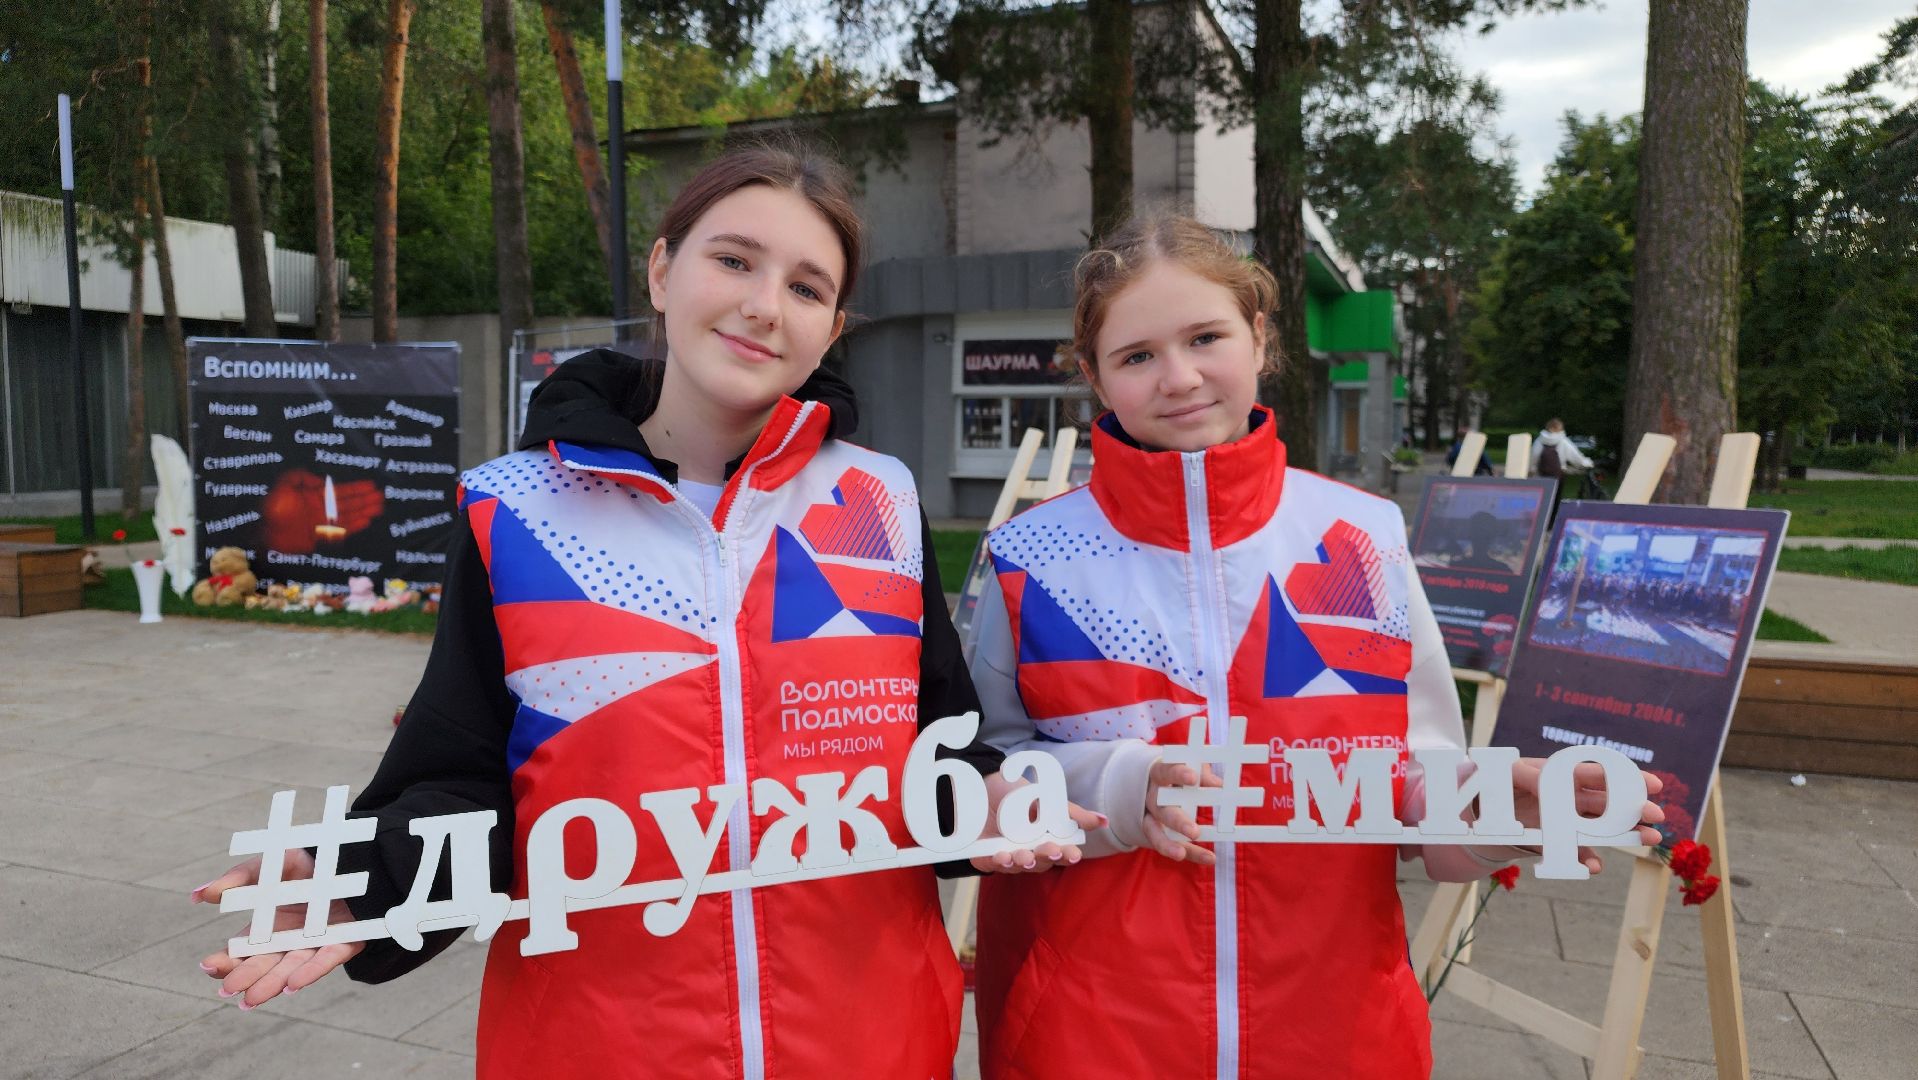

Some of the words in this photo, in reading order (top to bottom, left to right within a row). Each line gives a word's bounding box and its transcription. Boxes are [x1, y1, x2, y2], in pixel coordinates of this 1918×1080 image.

[204, 356, 357, 381] Вспомним...
[965, 354, 1040, 371] ШАУРМА
[208, 401, 258, 416] Москва
[333, 415, 397, 430] Каспийск
[223, 424, 272, 443] Беслан
[294, 429, 345, 446] Самара
[374, 432, 432, 448] Грозный
[203, 452, 283, 470] Ставрополь
[385, 458, 456, 475] Астрахань
[205, 481, 268, 498] Гудермес
[384, 485, 444, 500] Воронеж
[205, 510, 260, 534] Назрань
[389, 512, 452, 538] Буйнакск
[267, 549, 382, 574] Санкт-Петербург
[395, 549, 446, 564] Нальчи
[1563, 689, 1632, 717] сентября
[781, 703, 918, 733] ПОДМОСКО
[784, 742, 815, 760] МЫ
[820, 735, 884, 757] РЯДОМ
[1156, 716, 1648, 880] #мир
[219, 711, 1086, 958] #дружба
